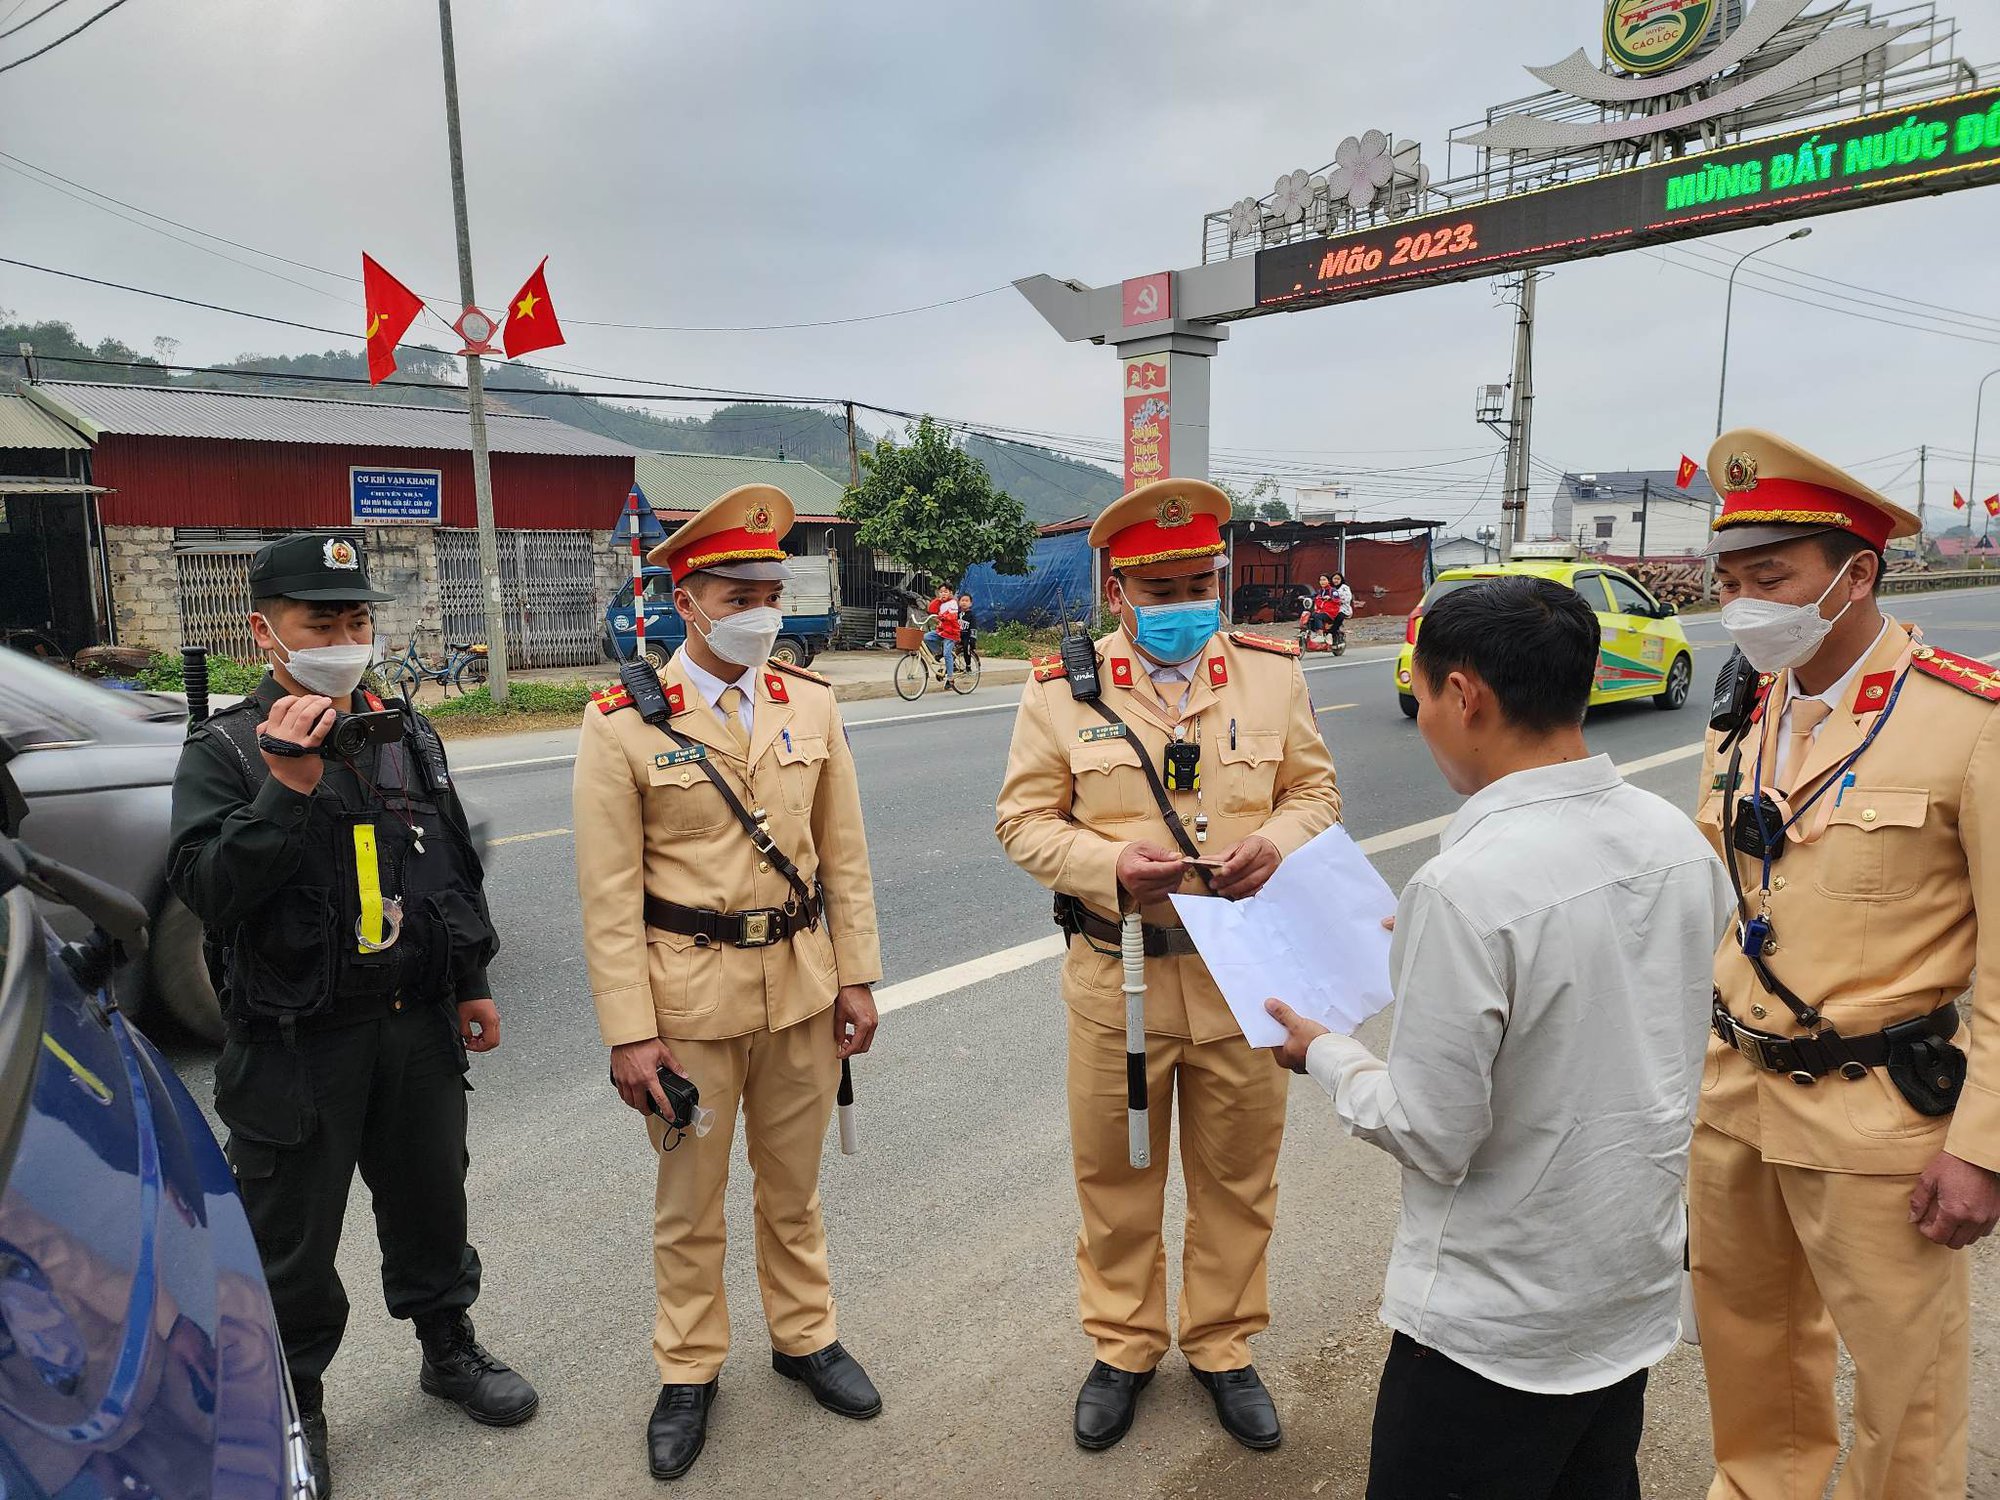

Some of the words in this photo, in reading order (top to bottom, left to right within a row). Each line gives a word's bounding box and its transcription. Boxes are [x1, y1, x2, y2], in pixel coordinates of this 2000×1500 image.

[1632, 38, 1655, 51] CAO
[1666, 160, 1763, 211] MỪNG
[1769, 135, 1838, 190] ĐẤT
[1844, 116, 1949, 176] NƯỚC
[1318, 244, 1383, 280] Mão
[1388, 223, 1477, 267] 2023.
[358, 475, 369, 483] CƠ
[370, 474, 385, 484] KHÍ
[387, 477, 405, 486] VẠN
[406, 478, 436, 486] KHANH
